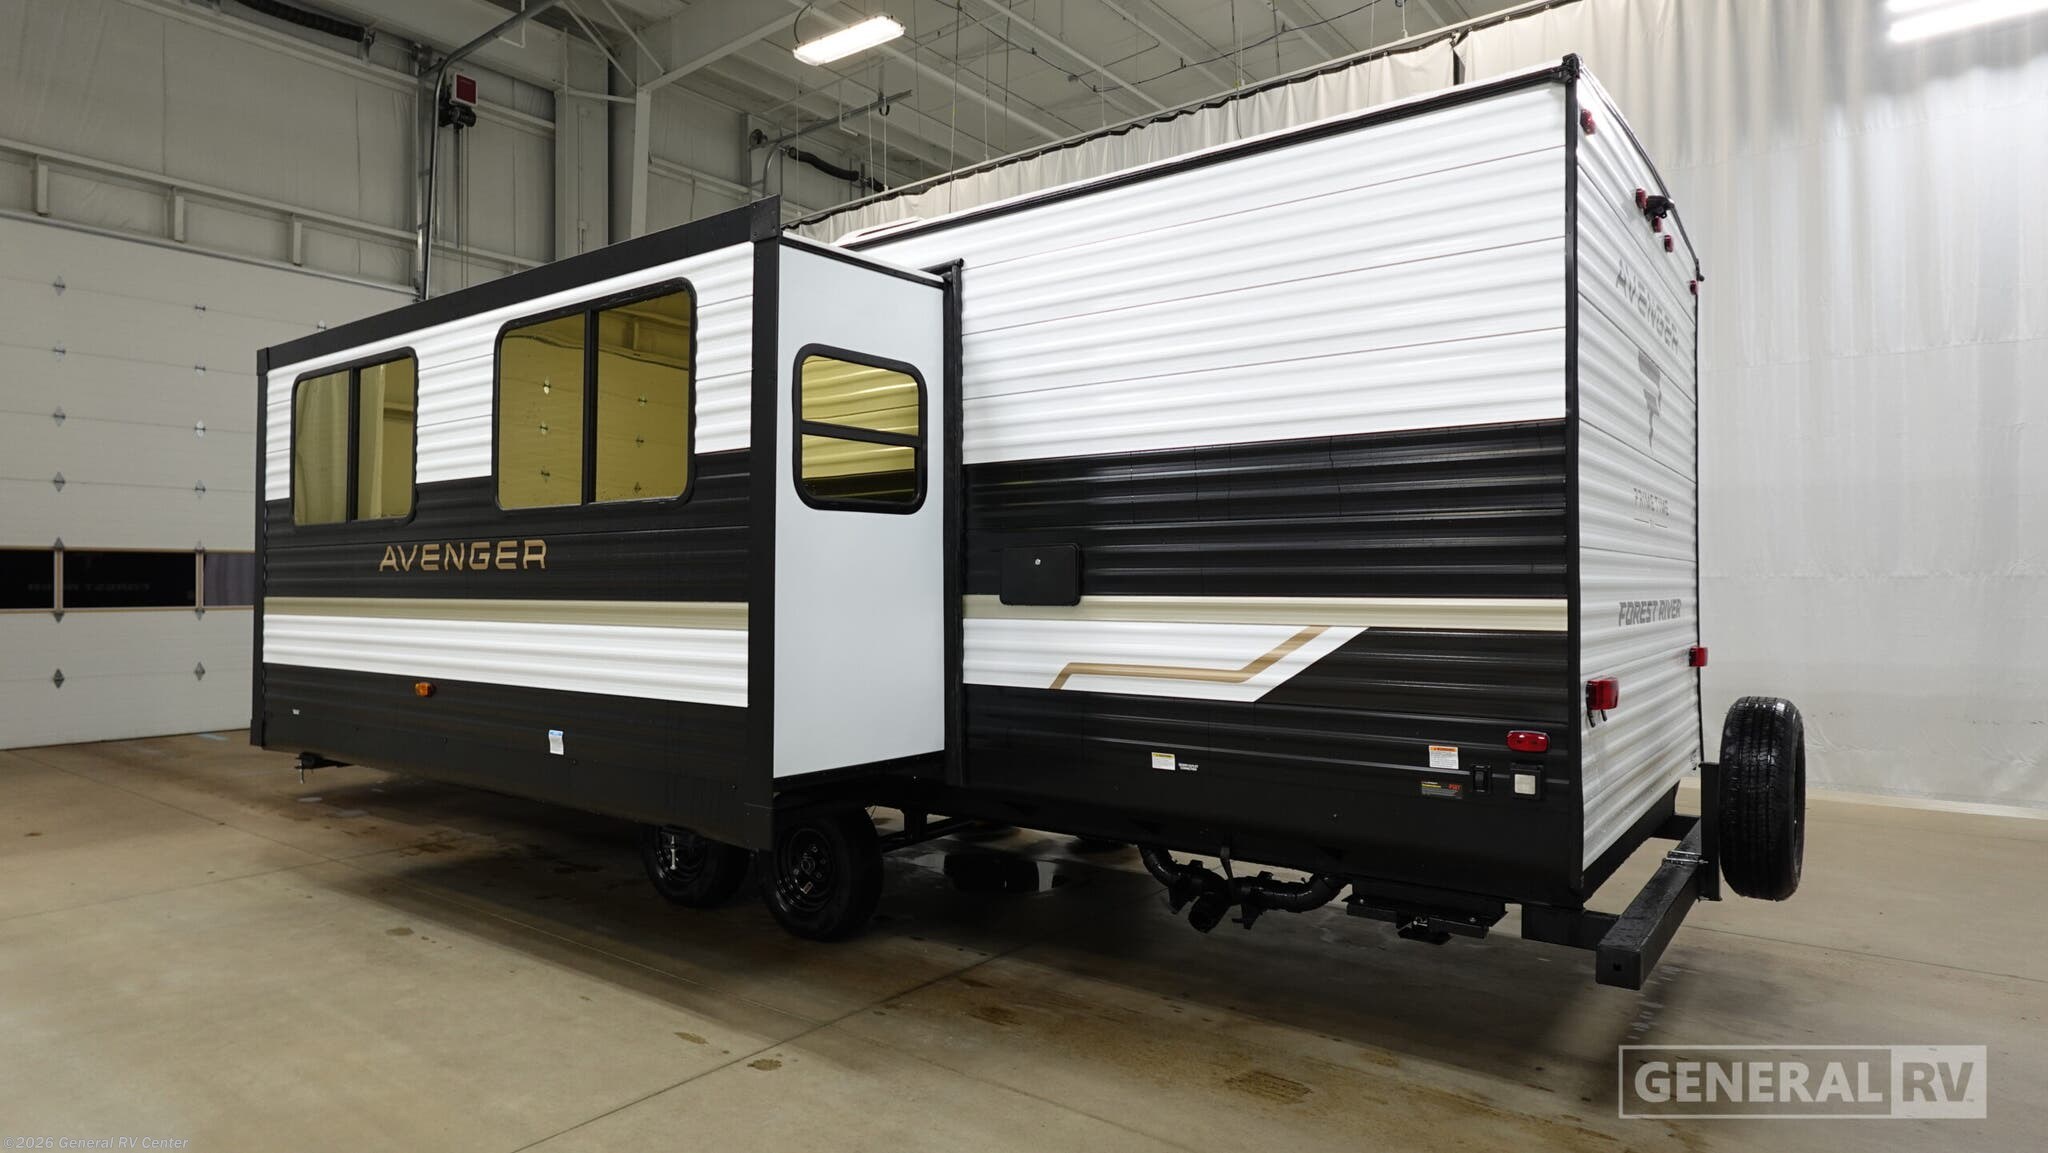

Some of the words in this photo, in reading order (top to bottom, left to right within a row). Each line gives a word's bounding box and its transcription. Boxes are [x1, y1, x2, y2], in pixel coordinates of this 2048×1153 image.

[1615, 259, 1679, 355] AVENGER
[379, 539, 547, 572] AVENGER
[1618, 600, 1658, 627] FOREST
[1658, 598, 1681, 621] RIVER
